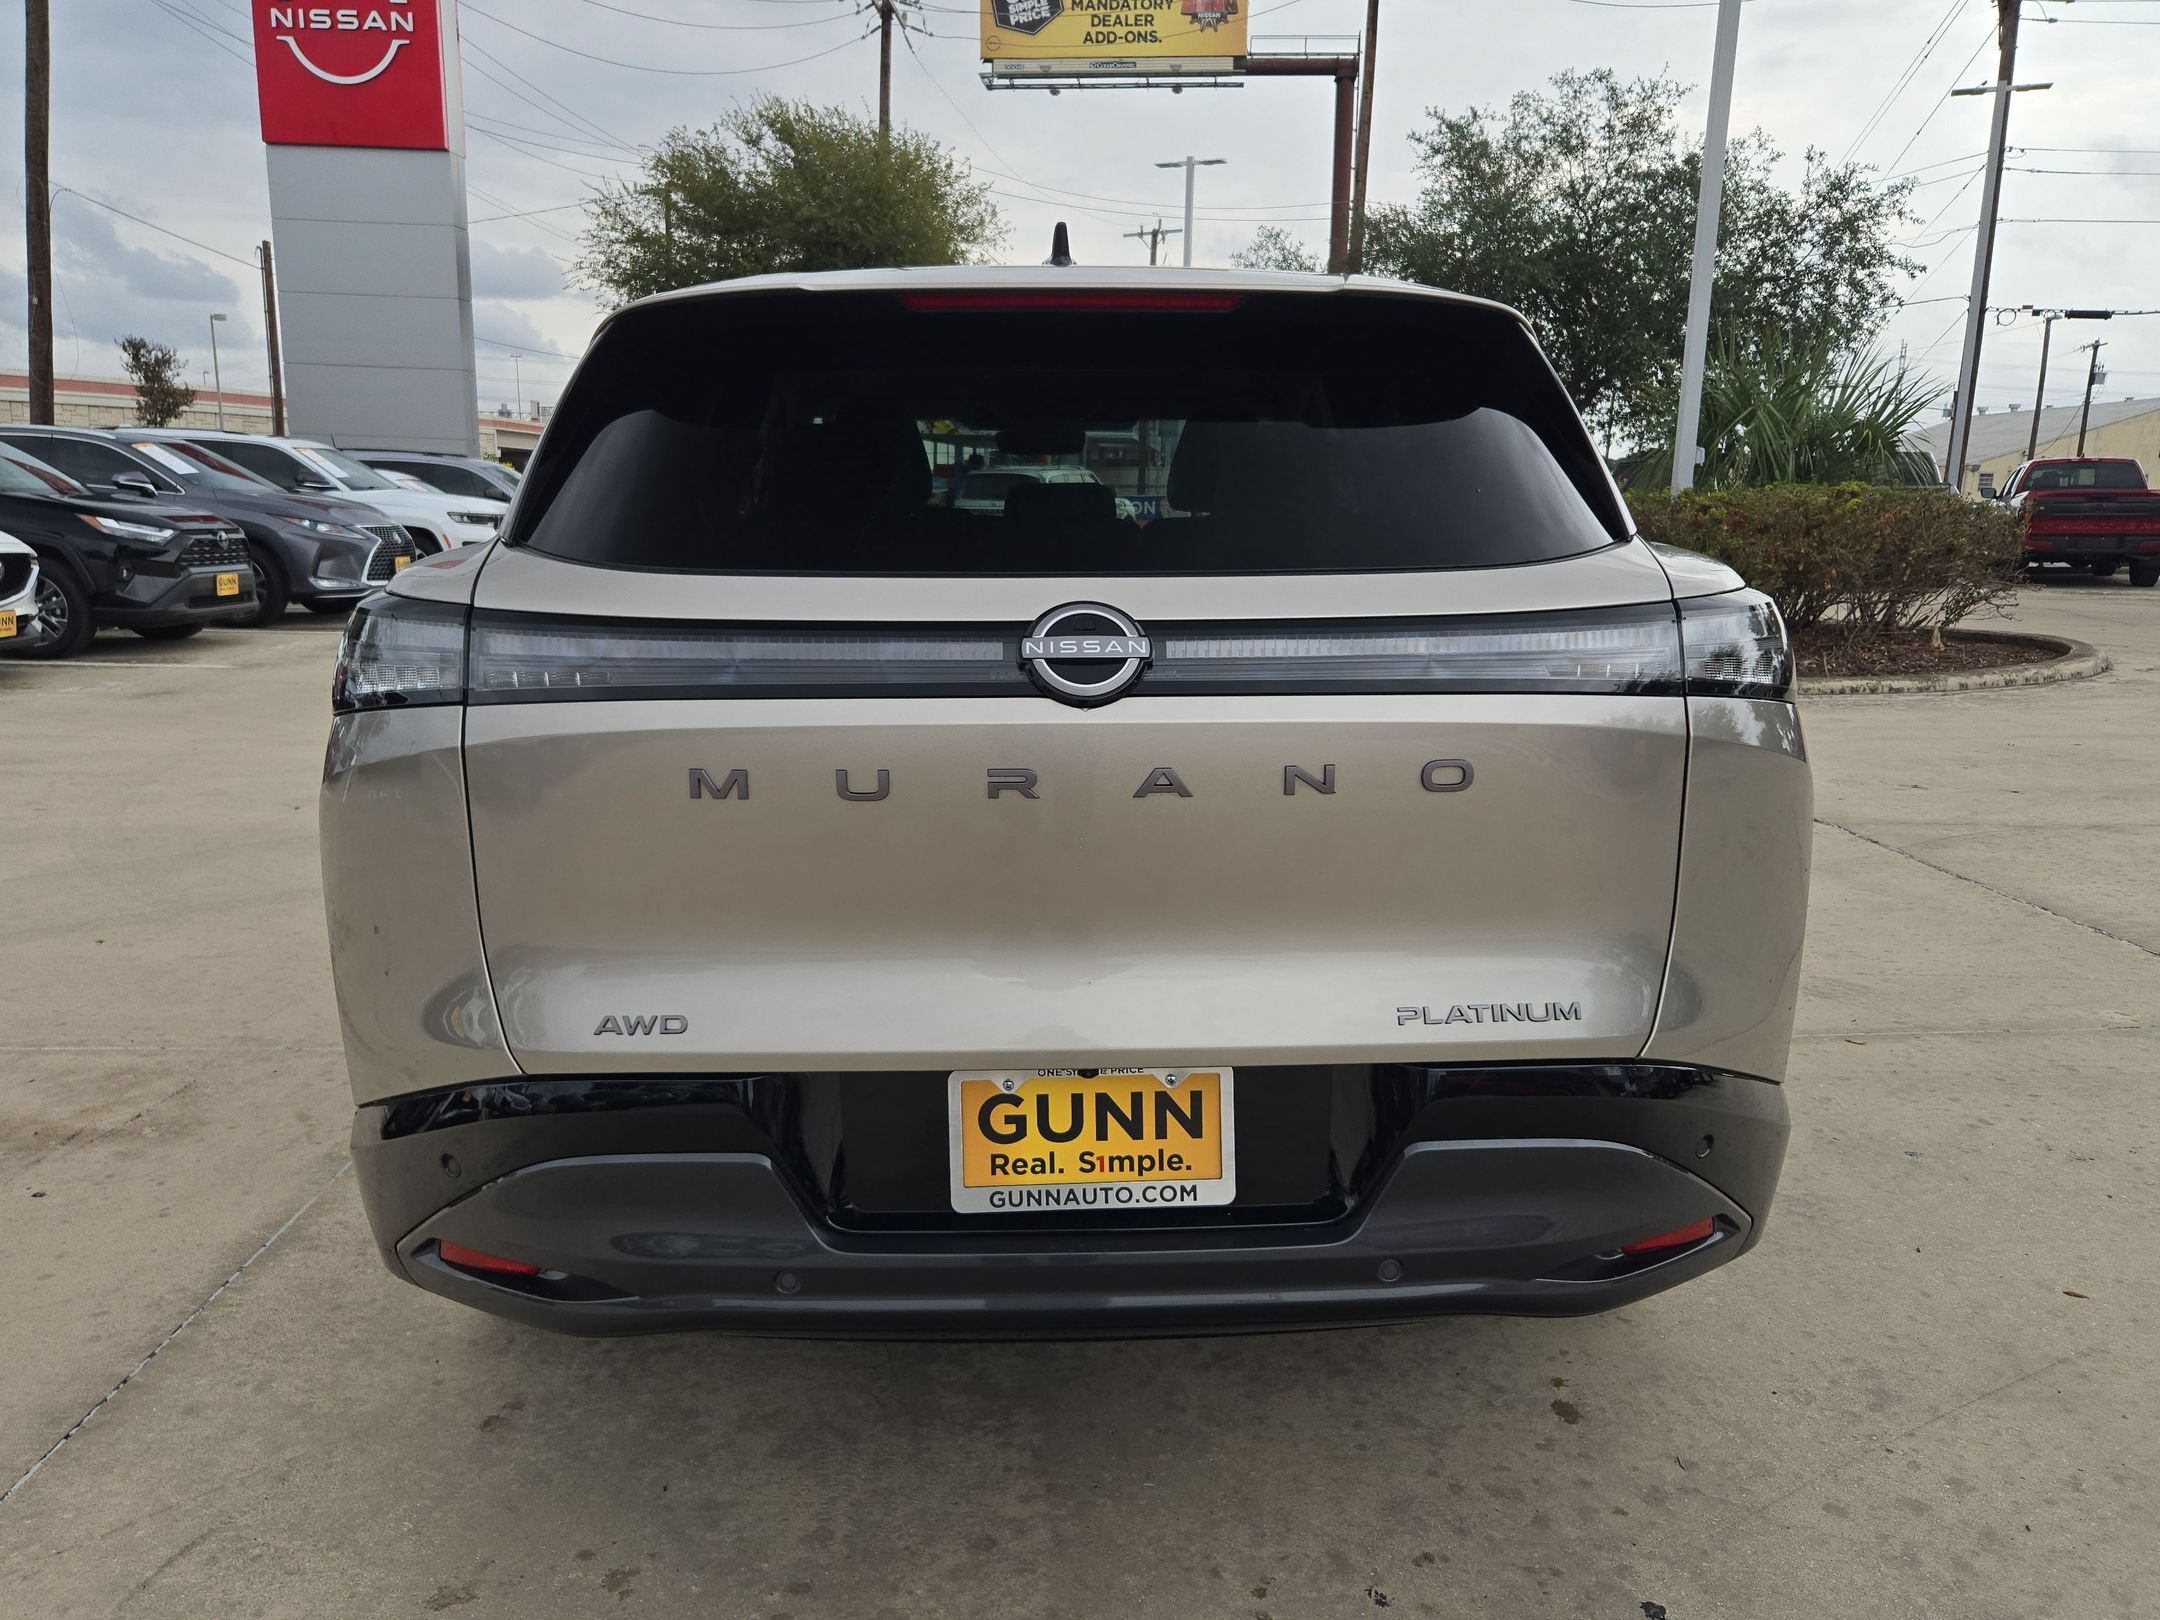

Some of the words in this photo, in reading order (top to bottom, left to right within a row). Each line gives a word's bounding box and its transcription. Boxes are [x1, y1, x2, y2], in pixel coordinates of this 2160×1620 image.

[1008, 0, 1049, 14] SIMPLE
[1009, 5, 1051, 26] PRICE
[1071, 0, 1174, 11] MANDATORY
[270, 7, 414, 32] NISSAN
[1090, 13, 1155, 28] DEALER
[1083, 30, 1163, 45] ADD-ONS.
[1025, 640, 1147, 654] NISSAN
[688, 758, 1475, 802] MURANO
[1396, 1001, 1582, 1026] PLATINUM
[593, 1014, 689, 1036] AWD
[1037, 1068, 1062, 1077] ONE
[977, 1090, 1203, 1144] GUNN
[990, 1151, 1065, 1176] Real.
[989, 1184, 1198, 1208] GUNNAUTO.COM
